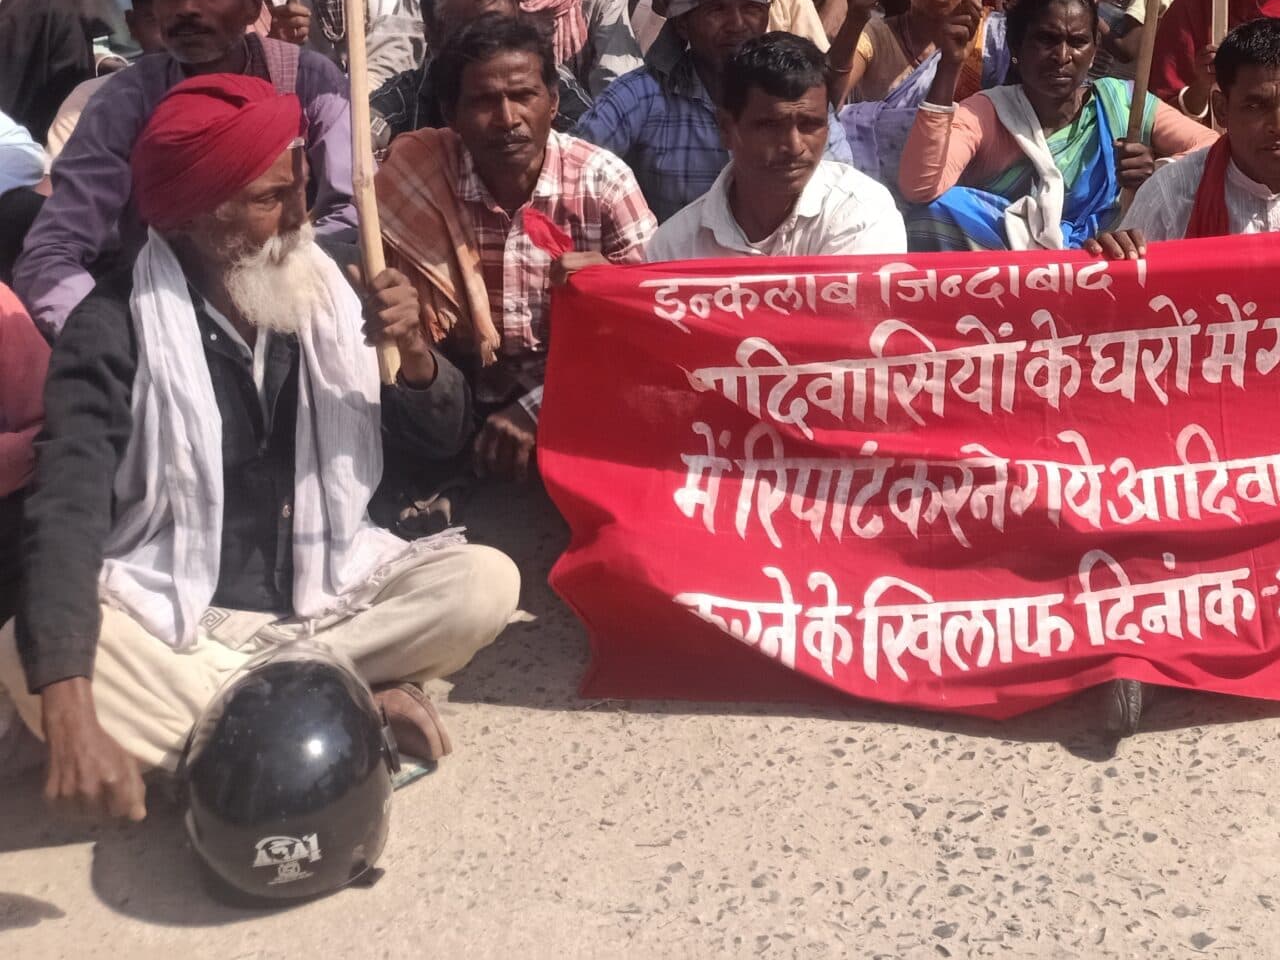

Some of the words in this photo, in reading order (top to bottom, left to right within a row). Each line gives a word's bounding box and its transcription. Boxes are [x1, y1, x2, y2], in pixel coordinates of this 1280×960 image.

[639, 272, 862, 333] इन्कलाब
[1023, 310, 1082, 411] के
[1084, 295, 1200, 406] घरों
[1202, 293, 1258, 390] में
[673, 421, 732, 534] में
[889, 442, 1010, 548] करने
[1010, 430, 1106, 531] गये
[803, 571, 853, 679] के
[856, 576, 1074, 682] खिलाफ
